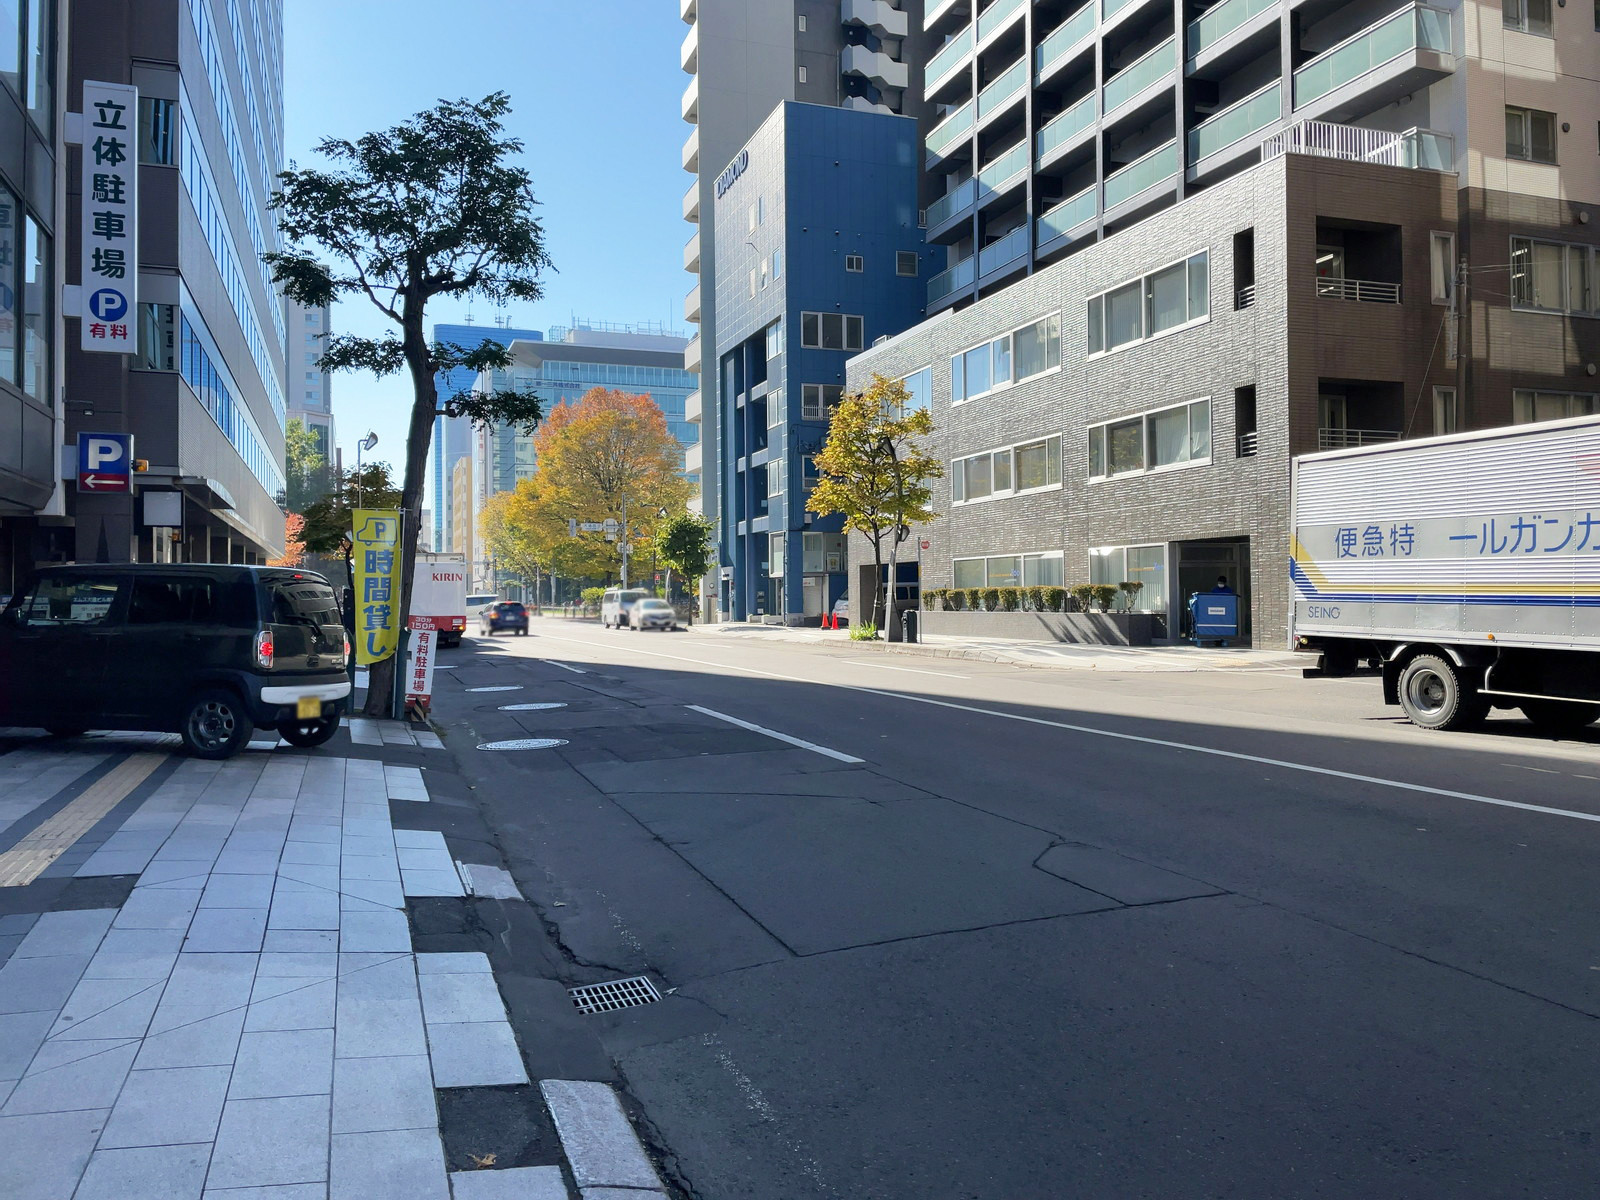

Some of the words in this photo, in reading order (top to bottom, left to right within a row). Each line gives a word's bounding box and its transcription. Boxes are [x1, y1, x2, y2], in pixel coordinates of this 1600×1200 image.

[91, 99, 127, 279] 立体駐車場
[717, 149, 749, 200] DIAMOND
[89, 323, 128, 340] 有料
[88, 438, 123, 470] P
[375, 521, 387, 539] P
[432, 572, 463, 582] KIRIN
[363, 549, 394, 656] 時間貸し
[411, 622, 436, 630] 150円
[412, 632, 431, 692] 有料駐車場
